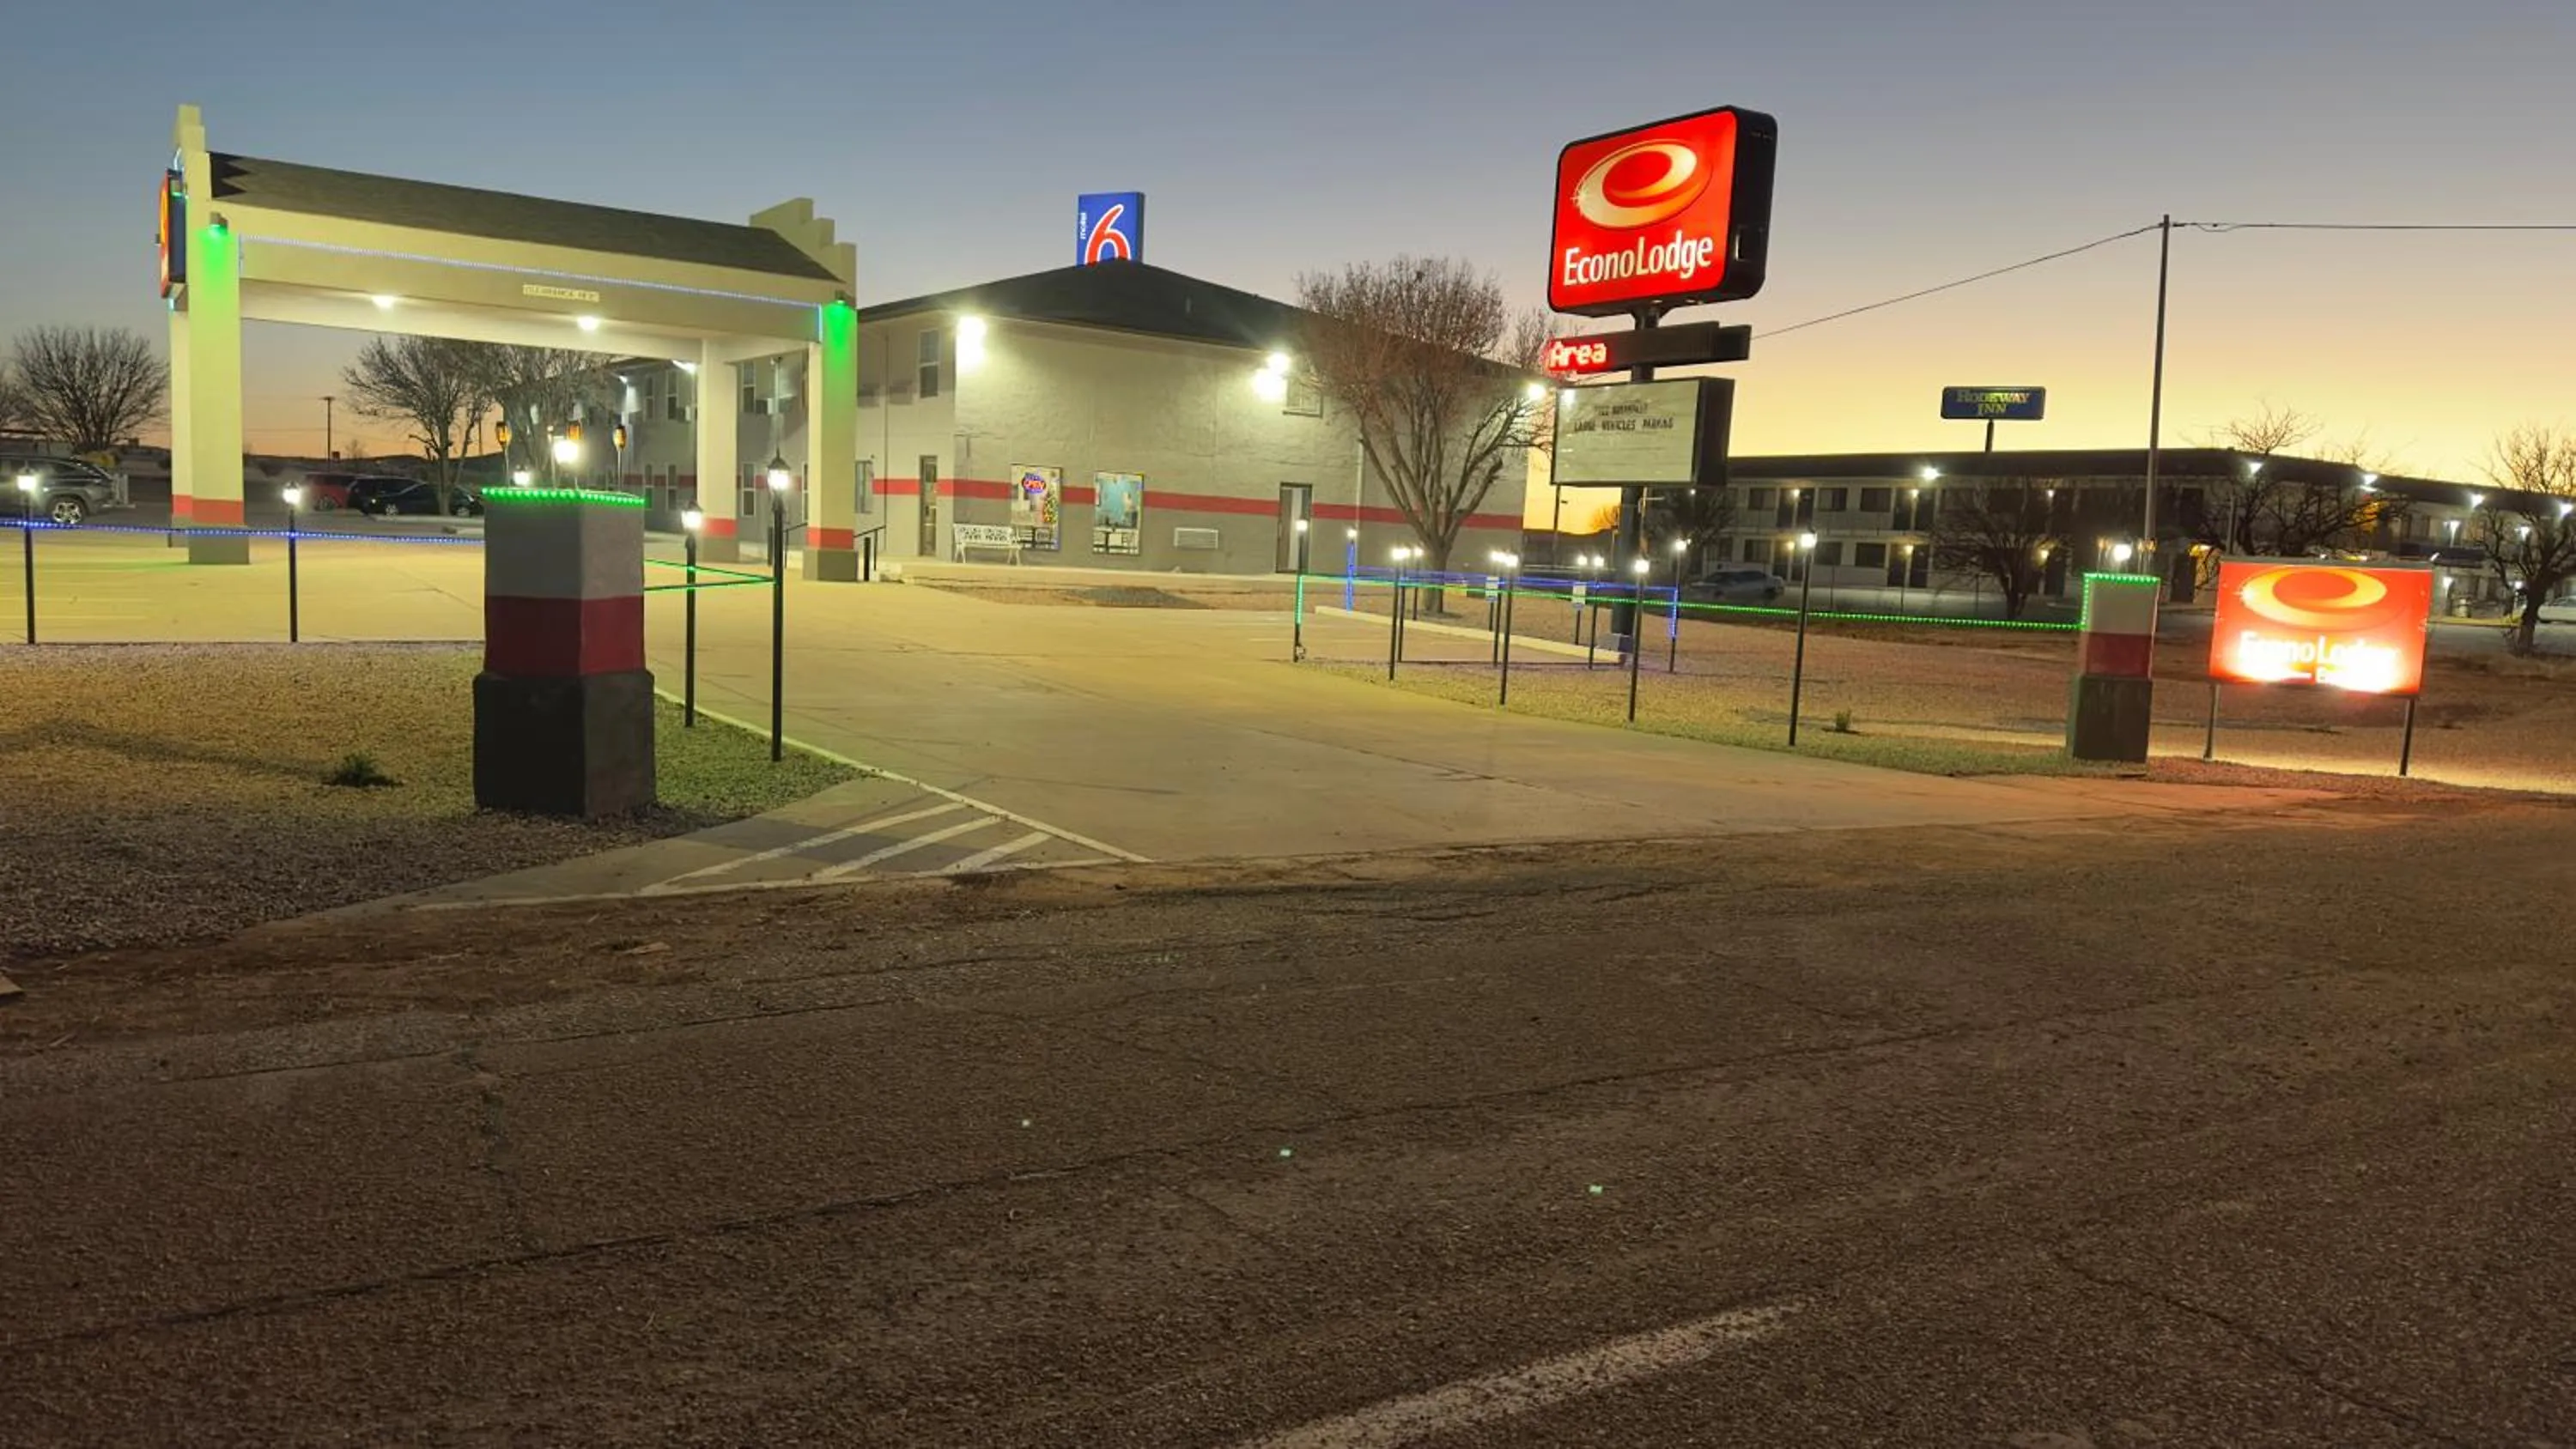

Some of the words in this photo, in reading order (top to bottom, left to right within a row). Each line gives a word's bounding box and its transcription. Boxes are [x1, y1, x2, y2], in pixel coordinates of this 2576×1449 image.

[1085, 203, 1132, 265] 6
[1564, 229, 1713, 287] EconoLodge
[1549, 341, 1607, 368] Area
